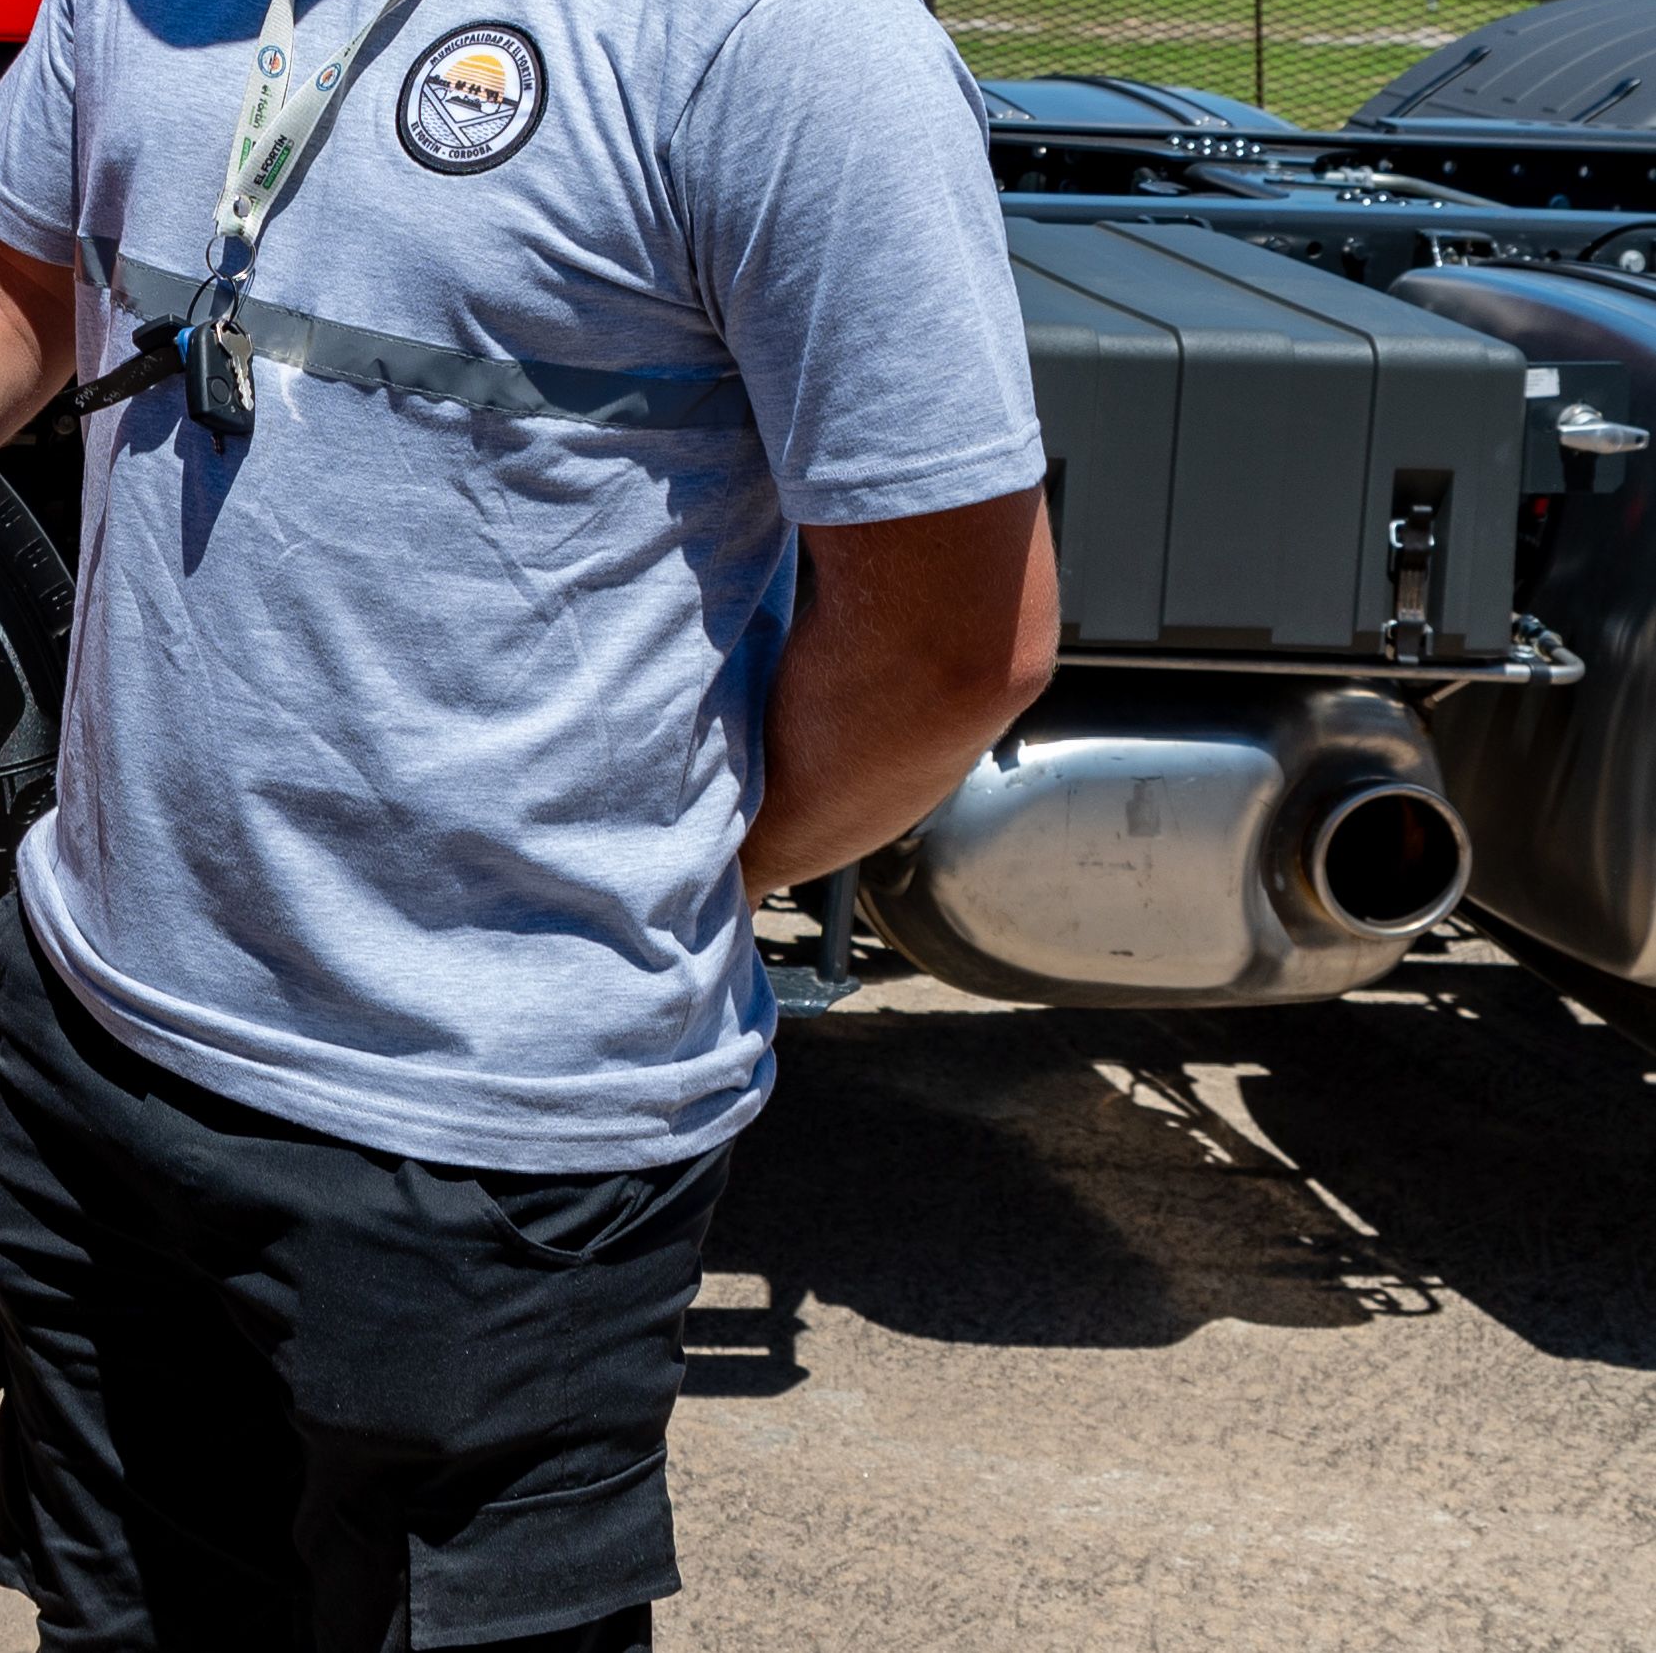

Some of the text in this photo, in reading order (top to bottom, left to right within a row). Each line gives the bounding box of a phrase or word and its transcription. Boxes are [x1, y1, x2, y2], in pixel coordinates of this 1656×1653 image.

[429, 33, 535, 91] MUNICIPALIDAD DE EL FORTÍN
[411, 121, 418, 133] EL
